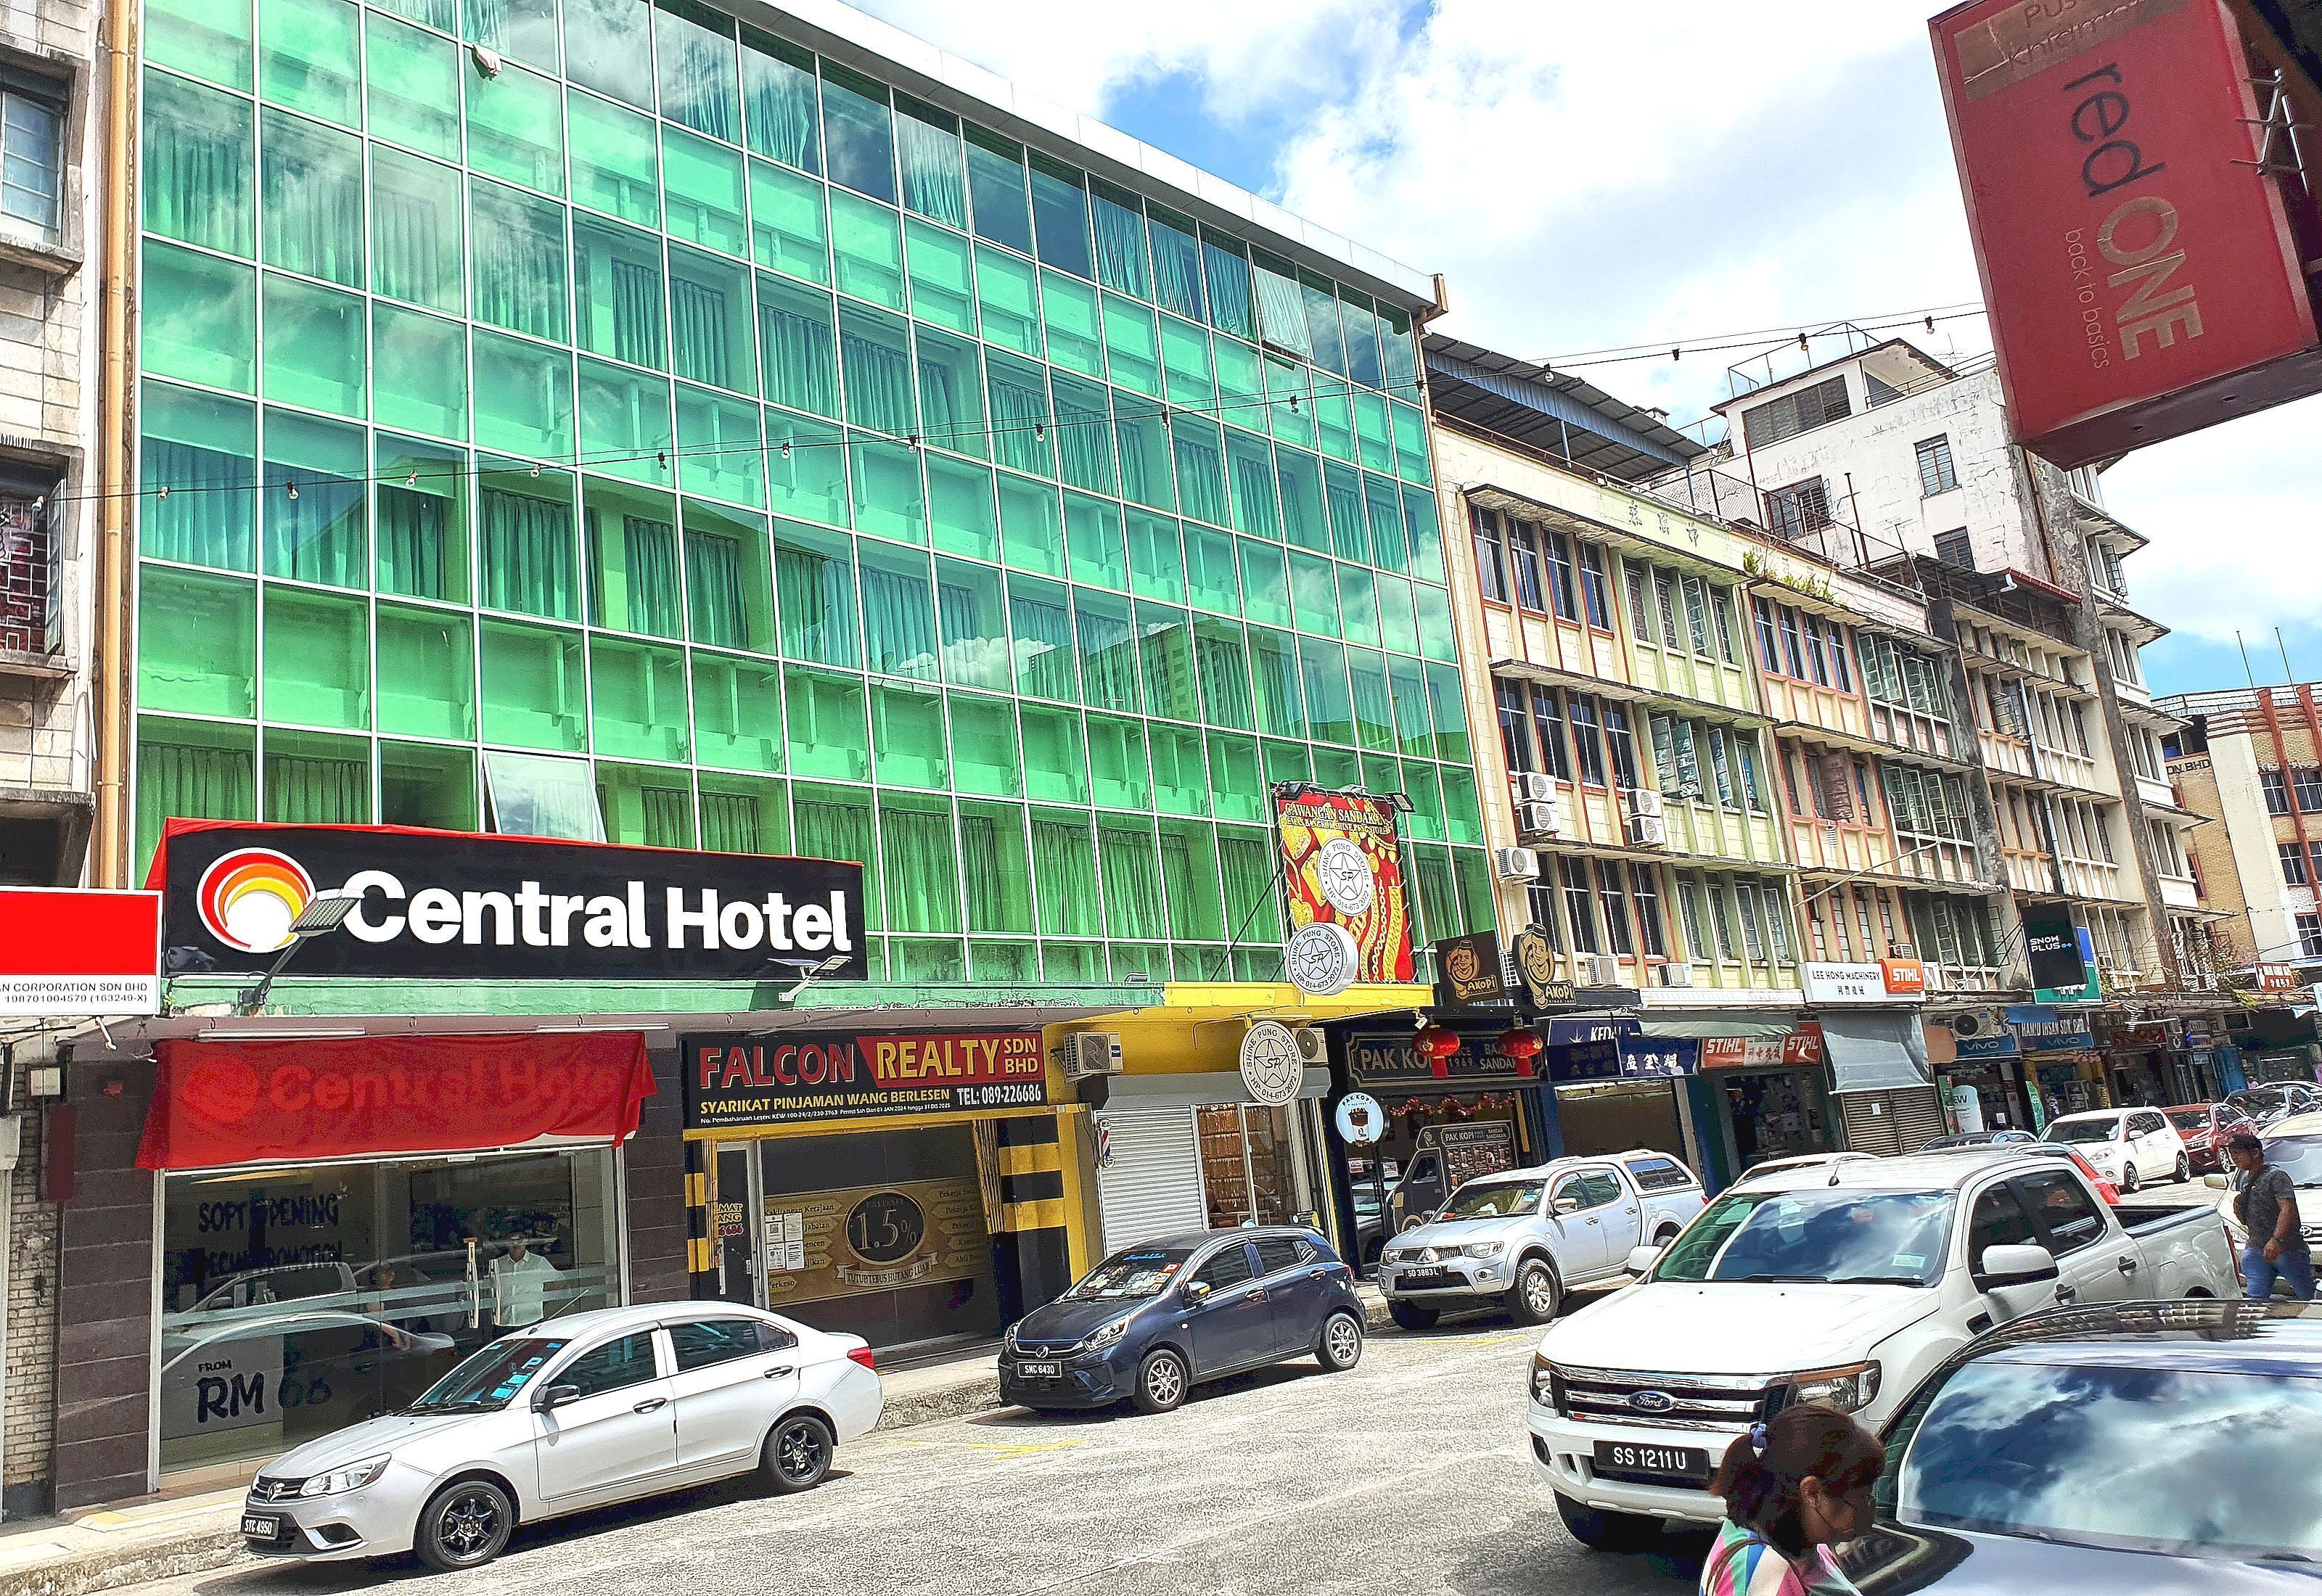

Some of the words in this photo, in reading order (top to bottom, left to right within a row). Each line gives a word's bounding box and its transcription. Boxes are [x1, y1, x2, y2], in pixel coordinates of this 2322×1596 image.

[2064, 228, 2093, 280] back
[2077, 283, 2096, 303] to
[2083, 307, 2109, 369] basics
[2184, 759, 2211, 771] BHD
[1285, 802, 1337, 821] CAWANGAN
[1322, 850, 1332, 877] SHINE
[1332, 843, 1350, 852] PUNG
[1354, 852, 1369, 881] STORE
[1341, 871, 1353, 881] SP
[342, 871, 651, 948] Central
[666, 886, 852, 952] Hotel
[1292, 940, 1301, 965] SHINE
[1302, 930, 1321, 940] PUNG
[1324, 934, 1340, 958] STORE
[2030, 935, 2059, 946] SNOW
[2031, 942, 2061, 953] PLUS
[1310, 953, 1324, 963] SP
[1328, 966, 1339, 983] 2072
[1812, 971, 1825, 979] LEE
[1826, 971, 1845, 980] HONG
[1845, 971, 1880, 980] MACHINERY
[1892, 968, 1921, 982] STIHL
[0, 983, 9, 992] N
[14, 982, 96, 992] CORPORATION
[99, 982, 122, 992] SDN
[125, 982, 148, 992] BHD
[1247, 1038, 1256, 1067] SHINE
[1258, 1029, 1277, 1038] PUNG
[1281, 1035, 1297, 1065] STORE
[1706, 1038, 1742, 1054] STIHL
[1787, 1036, 1818, 1051] STIHL
[1964, 1040, 1999, 1050] vivo
[700, 1044, 855, 1089] FALCON
[877, 1040, 1000, 1079] REALTY
[1004, 1038, 1037, 1054] SDN
[1005, 1058, 1039, 1074] BHD
[1266, 1058, 1281, 1069] SP
[1361, 1048, 1398, 1070] PAK
[1262, 1089, 1287, 1098] 014-673
[1285, 1075, 1297, 1093] 2072
[700, 1098, 771, 1114] SYARIKAT
[774, 1093, 844, 1110] PINJAMAN
[847, 1092, 887, 1106] WANG
[890, 1089, 950, 1103] BERLESEN
[957, 1087, 980, 1106] TEL:
[982, 1085, 1041, 1104] 089-226686
[1342, 1096, 1354, 1106] PAK
[1356, 1095, 1372, 1104] KOPI
[1445, 1132, 1459, 1142] PAK
[1459, 1131, 1474, 1140] KOPI
[718, 1203, 744, 1213] MAT
[804, 1204, 834, 1213] Kerajaan
[805, 1222, 829, 1232] Jabatan
[888, 1268, 914, 1282] HUTANG
[198, 1360, 232, 1373] FROM
[1038, 1365, 1055, 1374] 6430
[197, 1373, 264, 1423] RM
[1637, 1394, 1663, 1407] Ford
[1614, 1447, 1635, 1465] SS
[1639, 1448, 1672, 1469] 1211
[1675, 1452, 1686, 1470] U
[245, 1518, 256, 1533] STC
